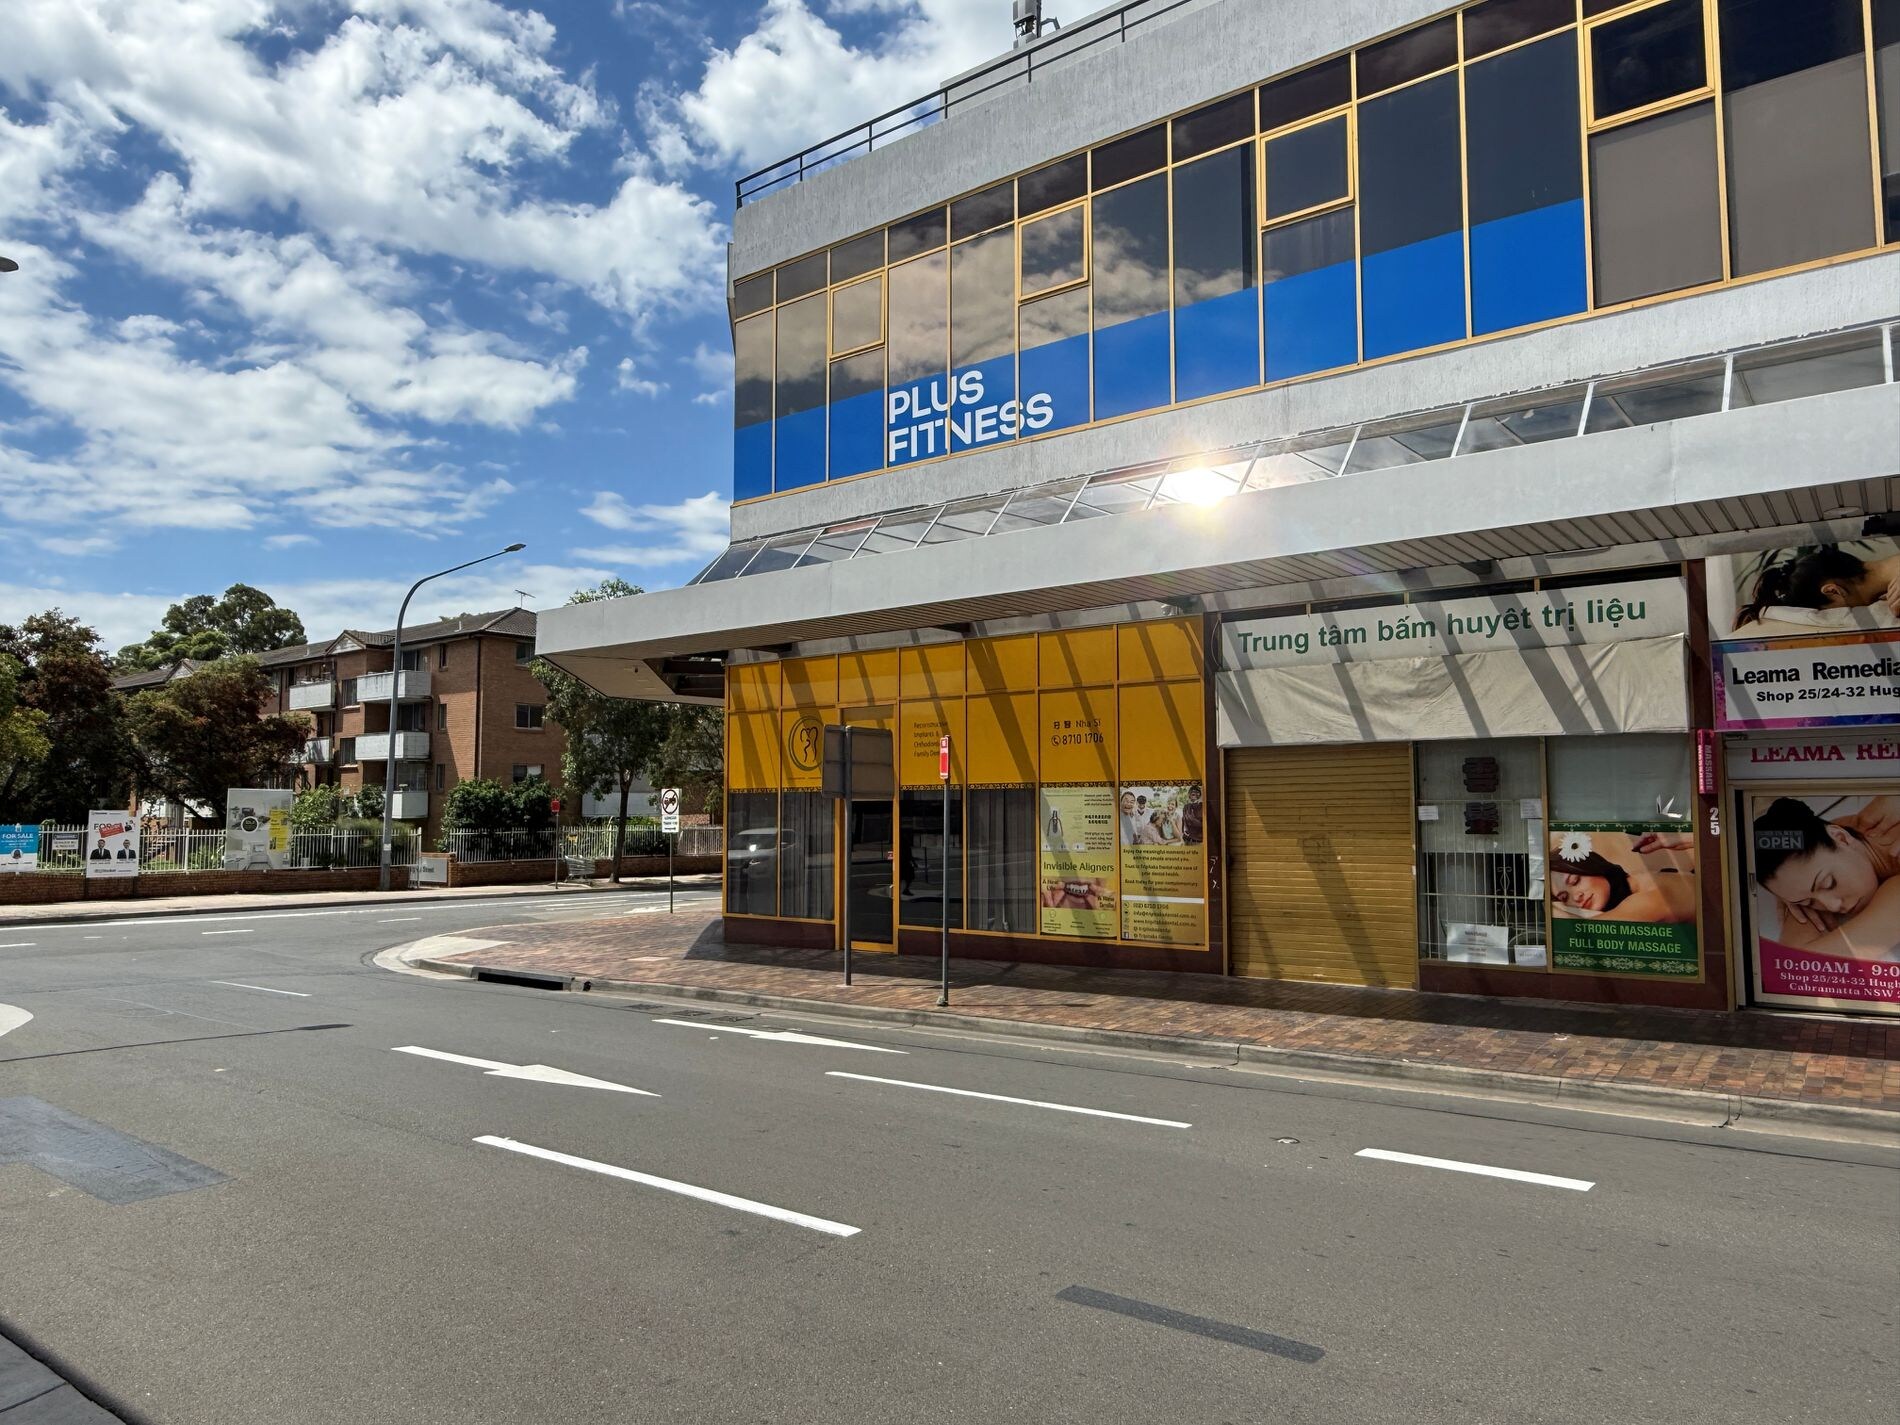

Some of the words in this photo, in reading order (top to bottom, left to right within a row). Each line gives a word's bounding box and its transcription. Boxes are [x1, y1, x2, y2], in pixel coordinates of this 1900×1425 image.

[889, 370, 985, 424] PLUS
[889, 393, 1054, 463] FITNESS
[1238, 632, 1309, 654] Trung
[1318, 625, 1367, 647] tâm
[1378, 615, 1436, 642] bấm
[1542, 602, 1575, 632] trị
[1587, 598, 1646, 628] liệu
[1732, 667, 1800, 685] Leama
[1757, 691, 1794, 703] Shop
[1798, 686, 1866, 700] 25/24-32
[1062, 733, 1082, 745] 8710
[1084, 732, 1104, 743] 1706
[1750, 745, 1846, 762] LEAMA
[1759, 837, 1802, 849] OPEN
[1043, 862, 1077, 871] Invisible
[1079, 862, 1115, 873] Aligners
[1575, 923, 1617, 934] STRONG
[1620, 925, 1673, 937] MASSAGE
[1569, 938, 1594, 949] FULL
[1596, 939, 1625, 950] BODY
[1628, 941, 1682, 953] MASSAGE
[1774, 959, 1850, 974] 10:00AM
[1780, 972, 1809, 983] Shop
[1812, 974, 1866, 986] 25/24-32
[1789, 982, 1860, 995] Cabramatta
[1863, 988, 1894, 998] NSW
